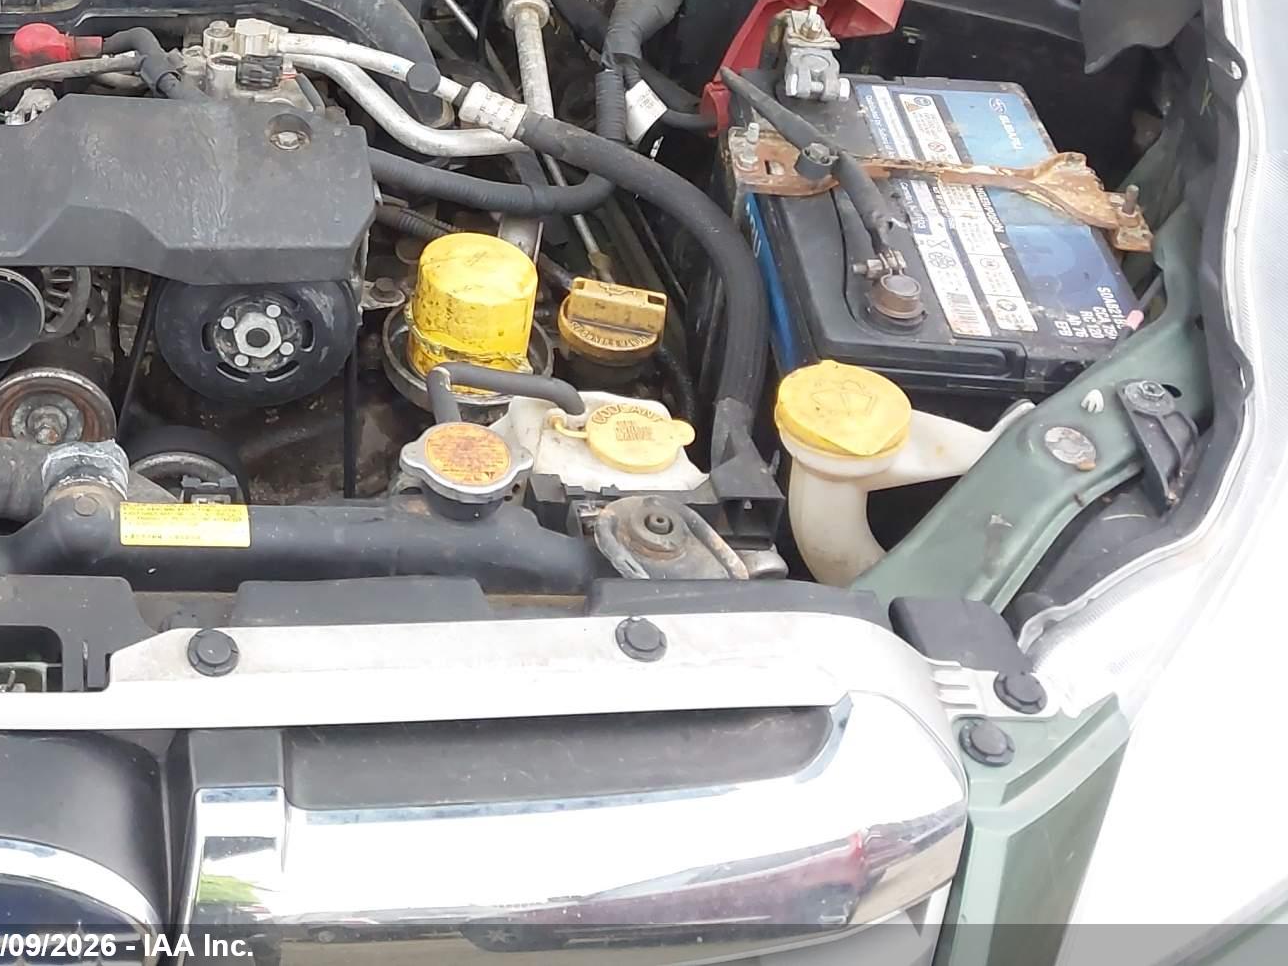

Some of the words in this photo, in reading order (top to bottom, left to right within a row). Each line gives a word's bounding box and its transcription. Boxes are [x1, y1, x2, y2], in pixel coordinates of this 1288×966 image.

[999, 114, 1024, 150] SUBARU
[1066, 314, 1082, 326] Ah
[1080, 310, 1096, 323] RC
[1054, 320, 1073, 336] EFB
[1087, 324, 1105, 338] 120
